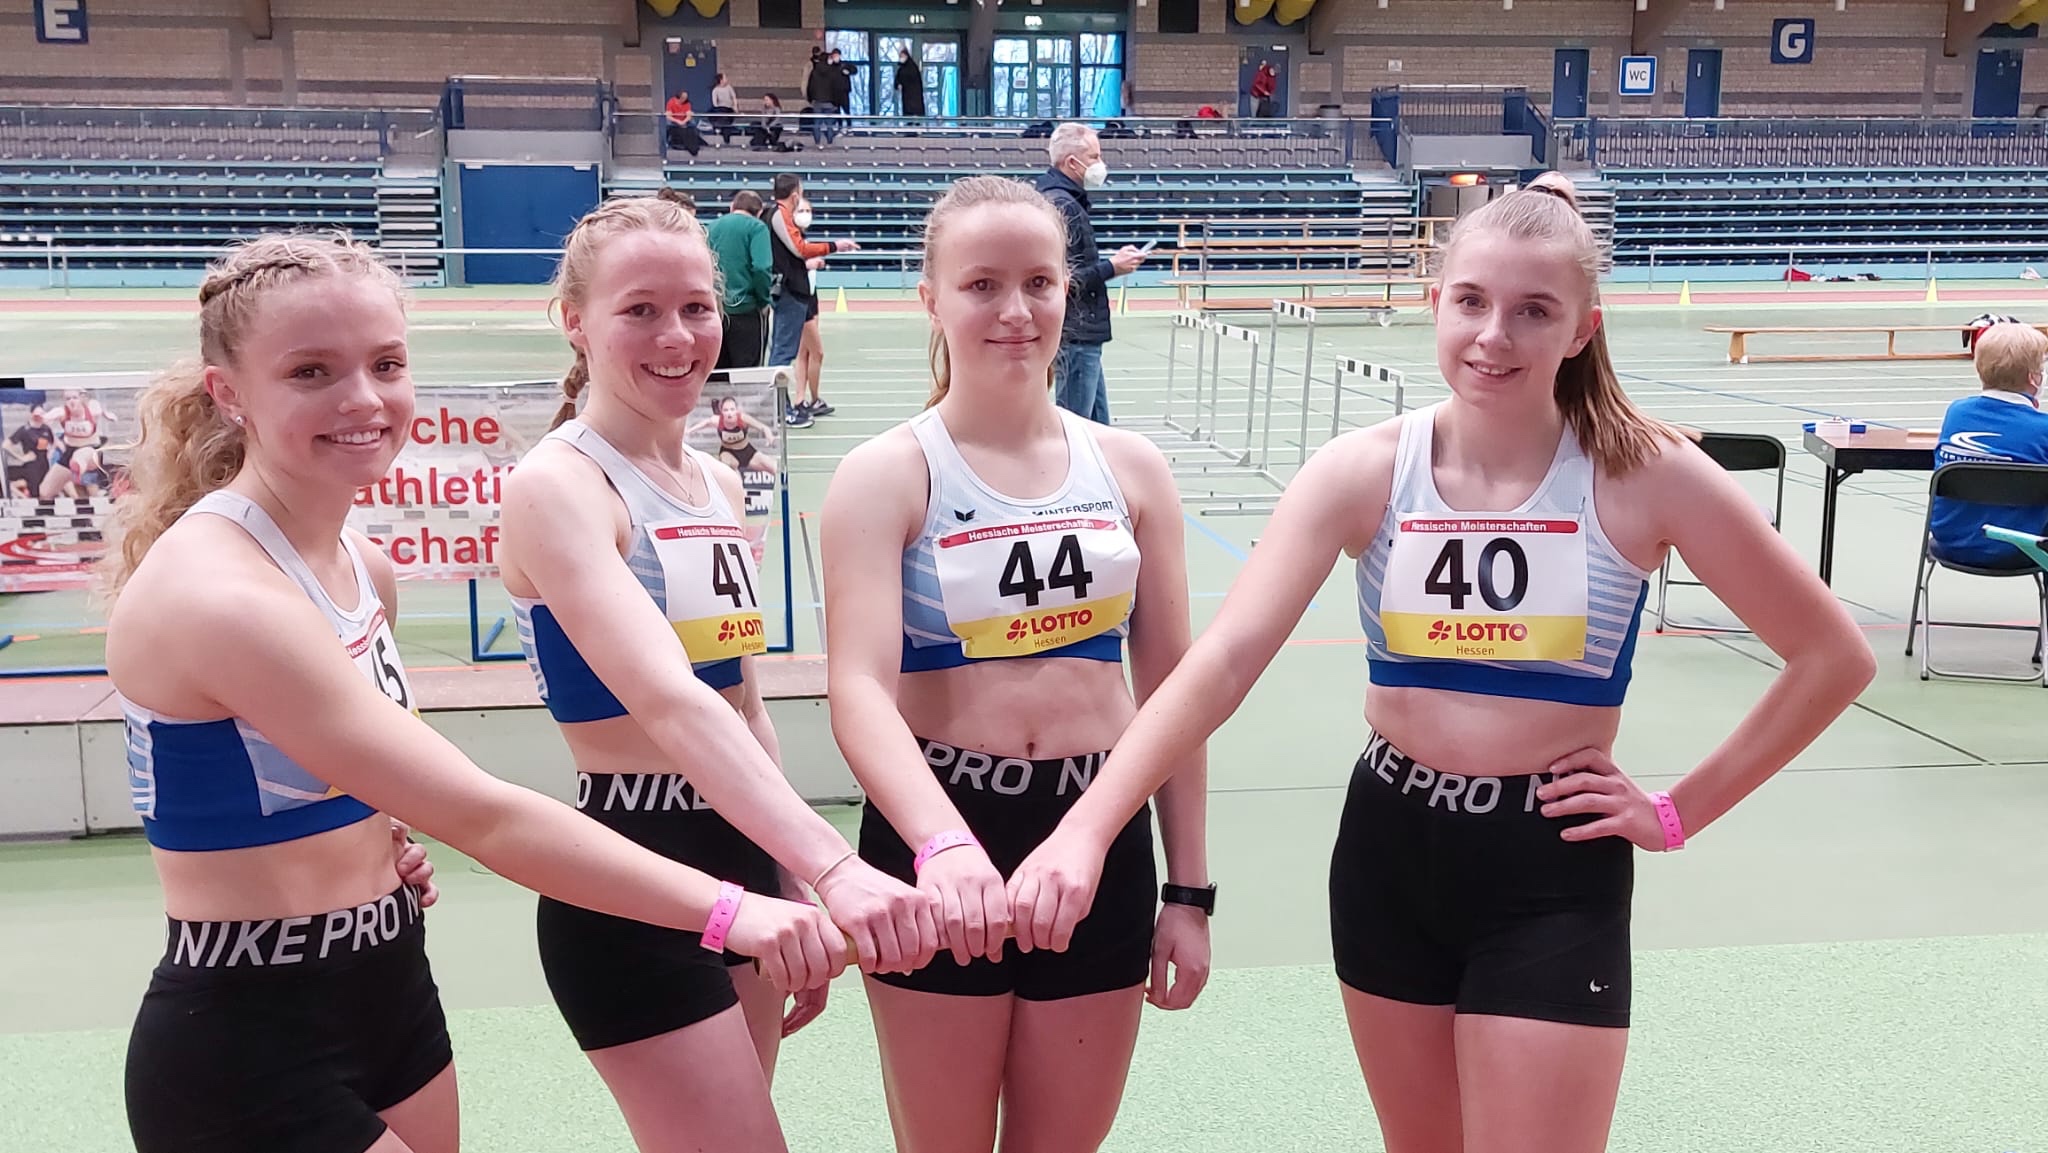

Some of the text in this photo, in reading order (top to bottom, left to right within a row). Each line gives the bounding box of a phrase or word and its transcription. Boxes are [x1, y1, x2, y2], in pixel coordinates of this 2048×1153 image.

[42, 0, 81, 39] E
[1779, 23, 1806, 59] G
[1629, 70, 1647, 81] WC
[411, 408, 499, 444] che
[354, 466, 515, 505] athleti
[1044, 501, 1114, 516] INTERSPORT
[1411, 521, 1547, 532] Hessische Meisterschaften
[968, 519, 1095, 541] Hessische Meisterschaften
[713, 543, 758, 608] 41
[998, 534, 1093, 607] 44
[1425, 537, 1529, 612] 40
[1031, 609, 1093, 635] LOTTO
[1456, 622, 1528, 642] LOTTO
[1034, 635, 1067, 648] Hessen
[1456, 645, 1495, 656] Hessen
[923, 740, 1034, 796] PRO
[1401, 762, 1503, 814] PRO
[173, 915, 312, 968] NIKE
[318, 895, 400, 959] PRO
